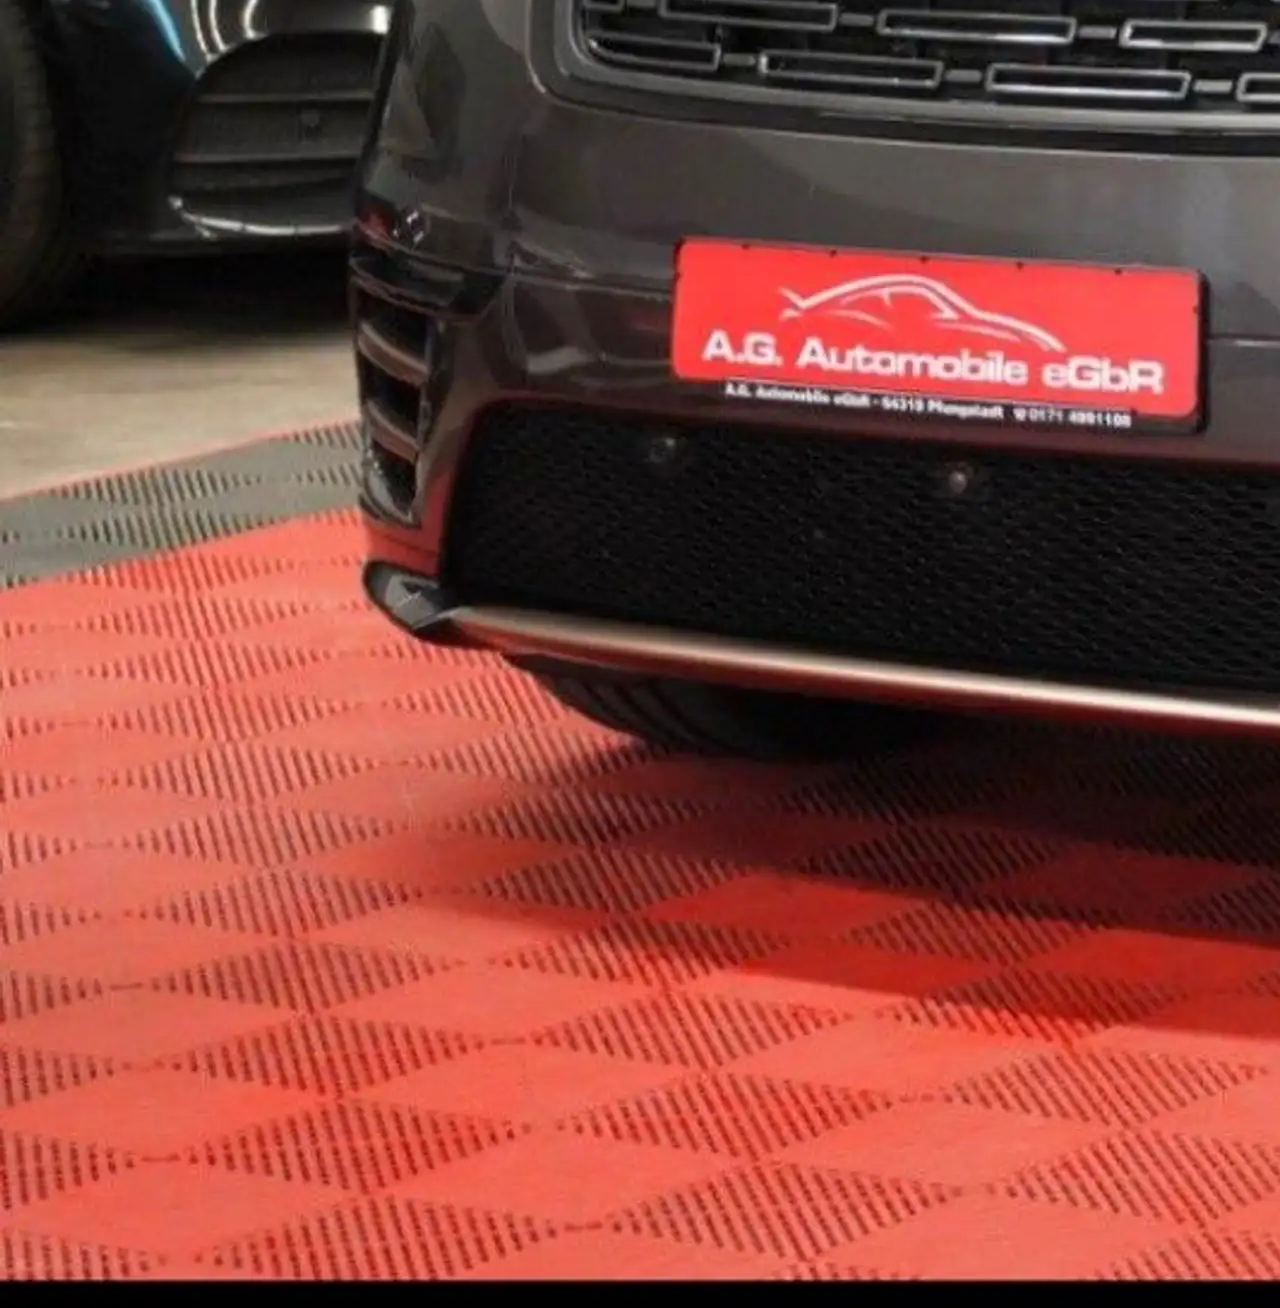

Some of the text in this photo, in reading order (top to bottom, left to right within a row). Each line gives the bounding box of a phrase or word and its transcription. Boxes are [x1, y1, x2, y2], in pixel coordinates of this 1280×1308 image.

[702, 328, 1163, 395] A.G. Automobile eGbR
